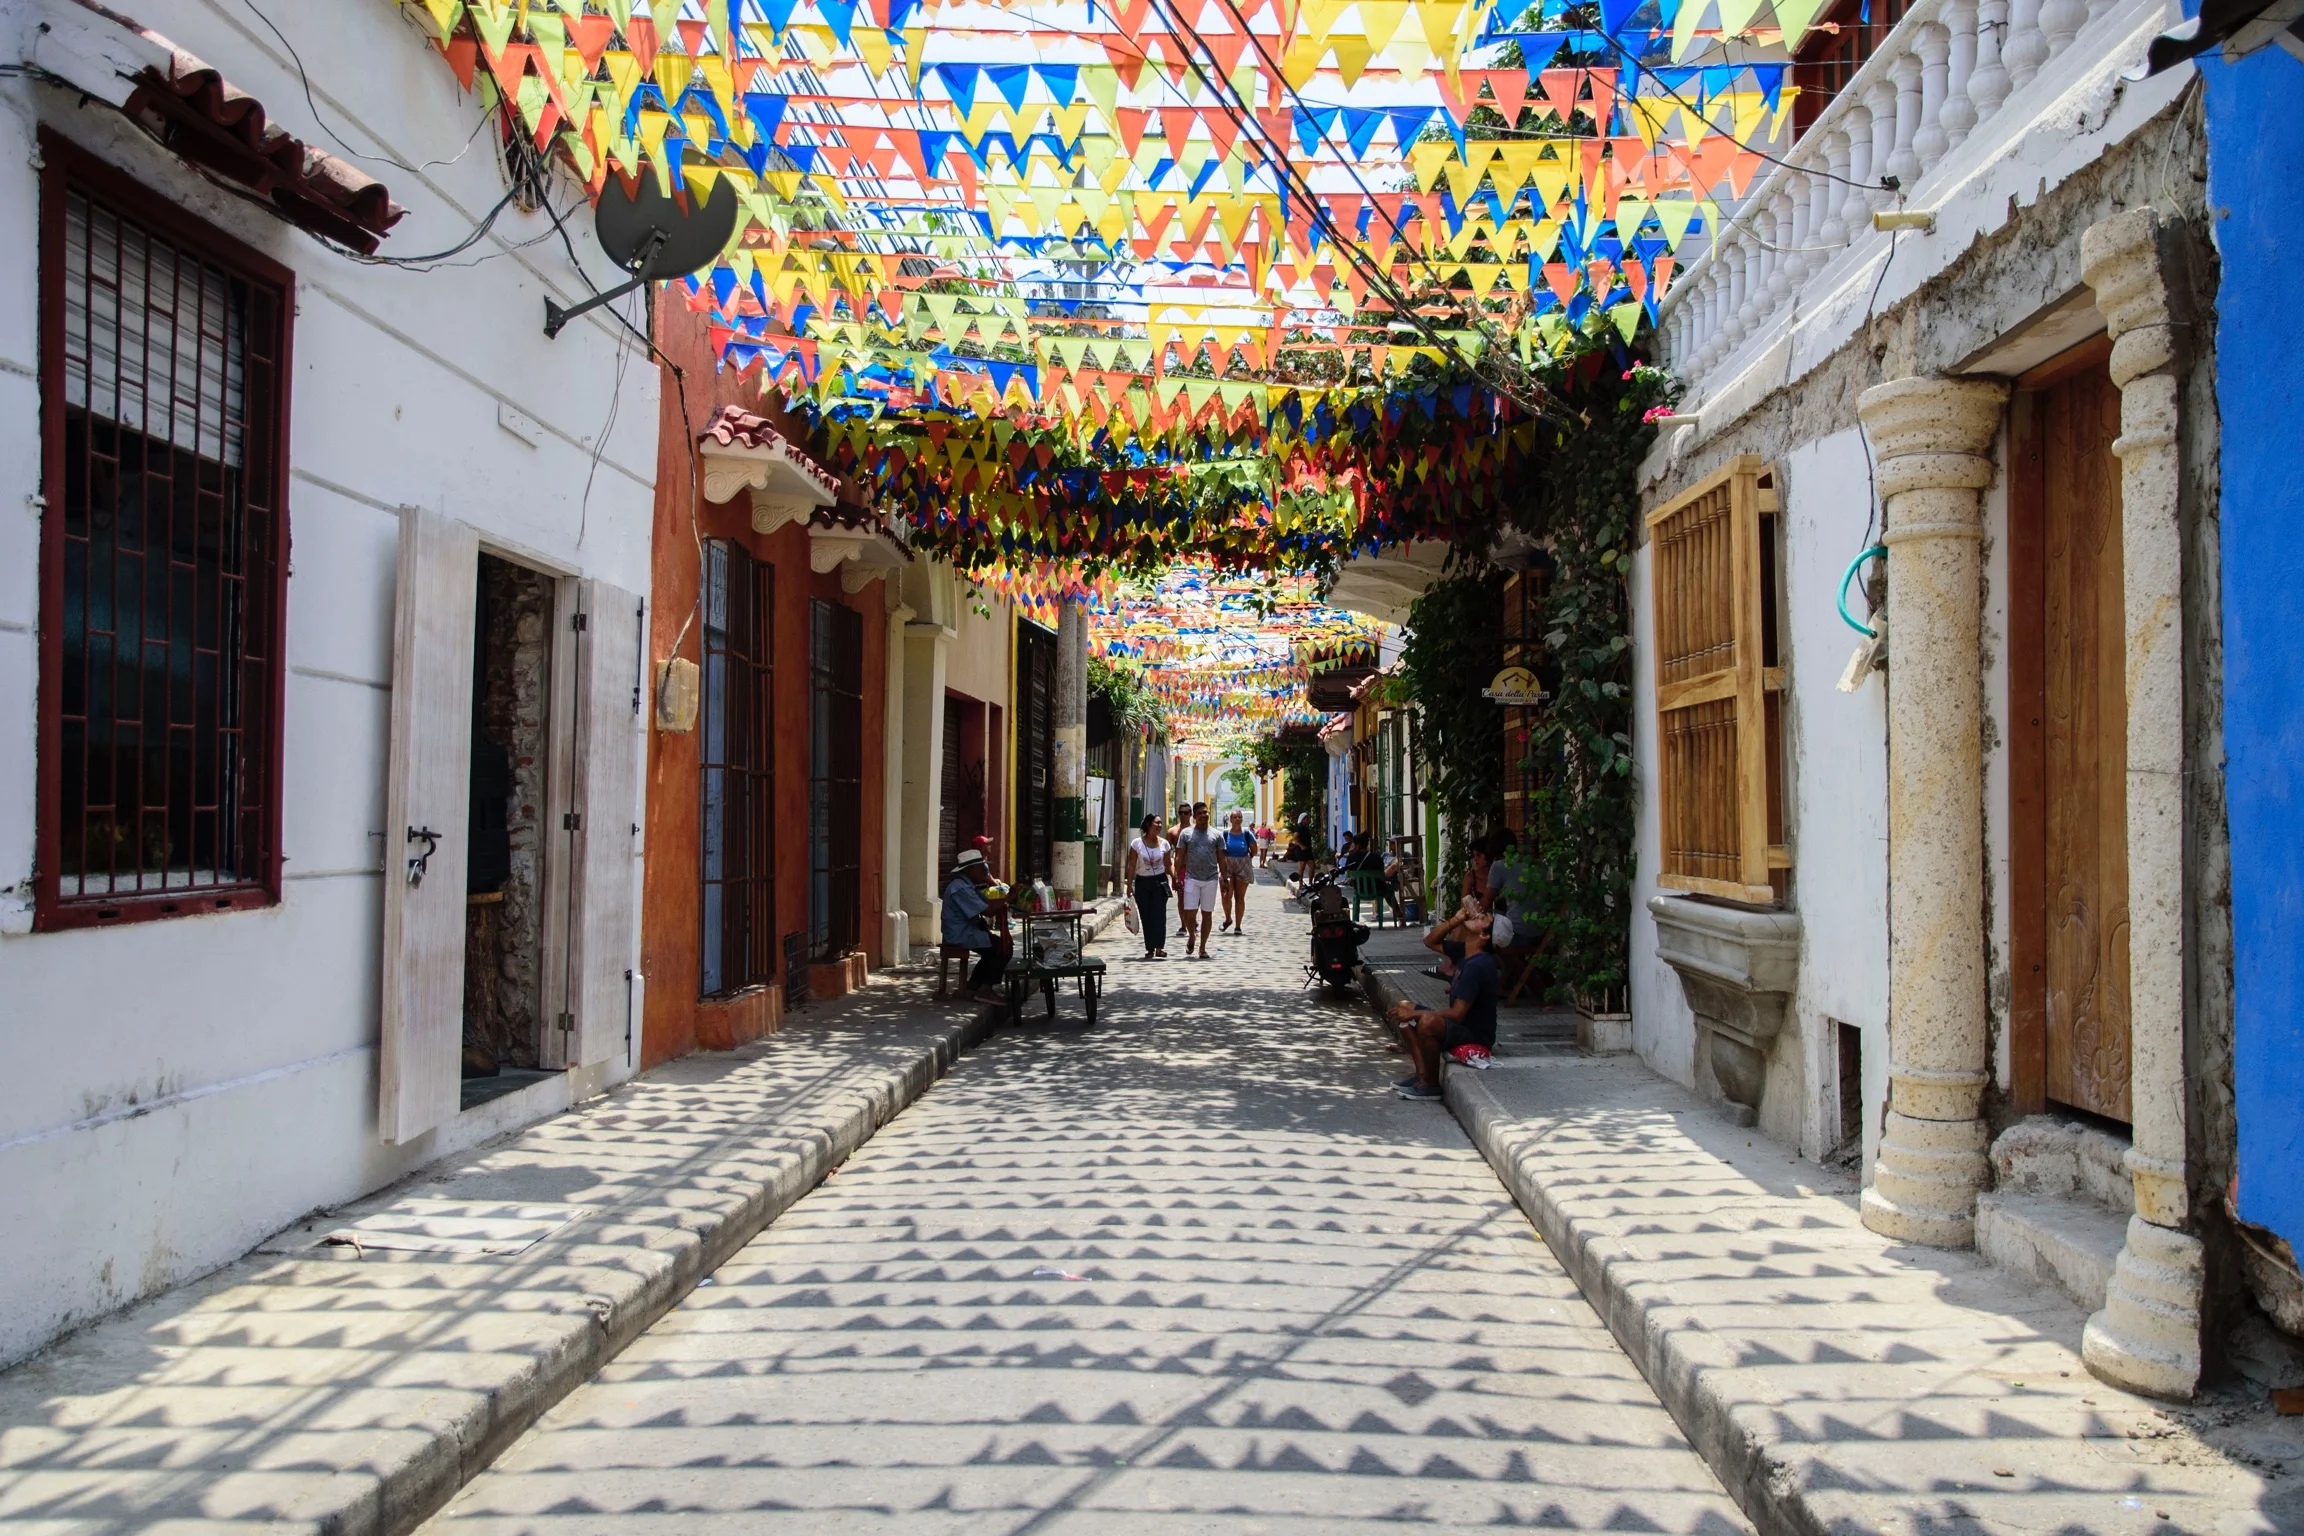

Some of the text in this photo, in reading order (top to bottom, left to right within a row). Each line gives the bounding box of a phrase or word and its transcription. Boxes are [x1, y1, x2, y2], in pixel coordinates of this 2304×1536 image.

[1482, 689, 1548, 698] Casa della Pasta
